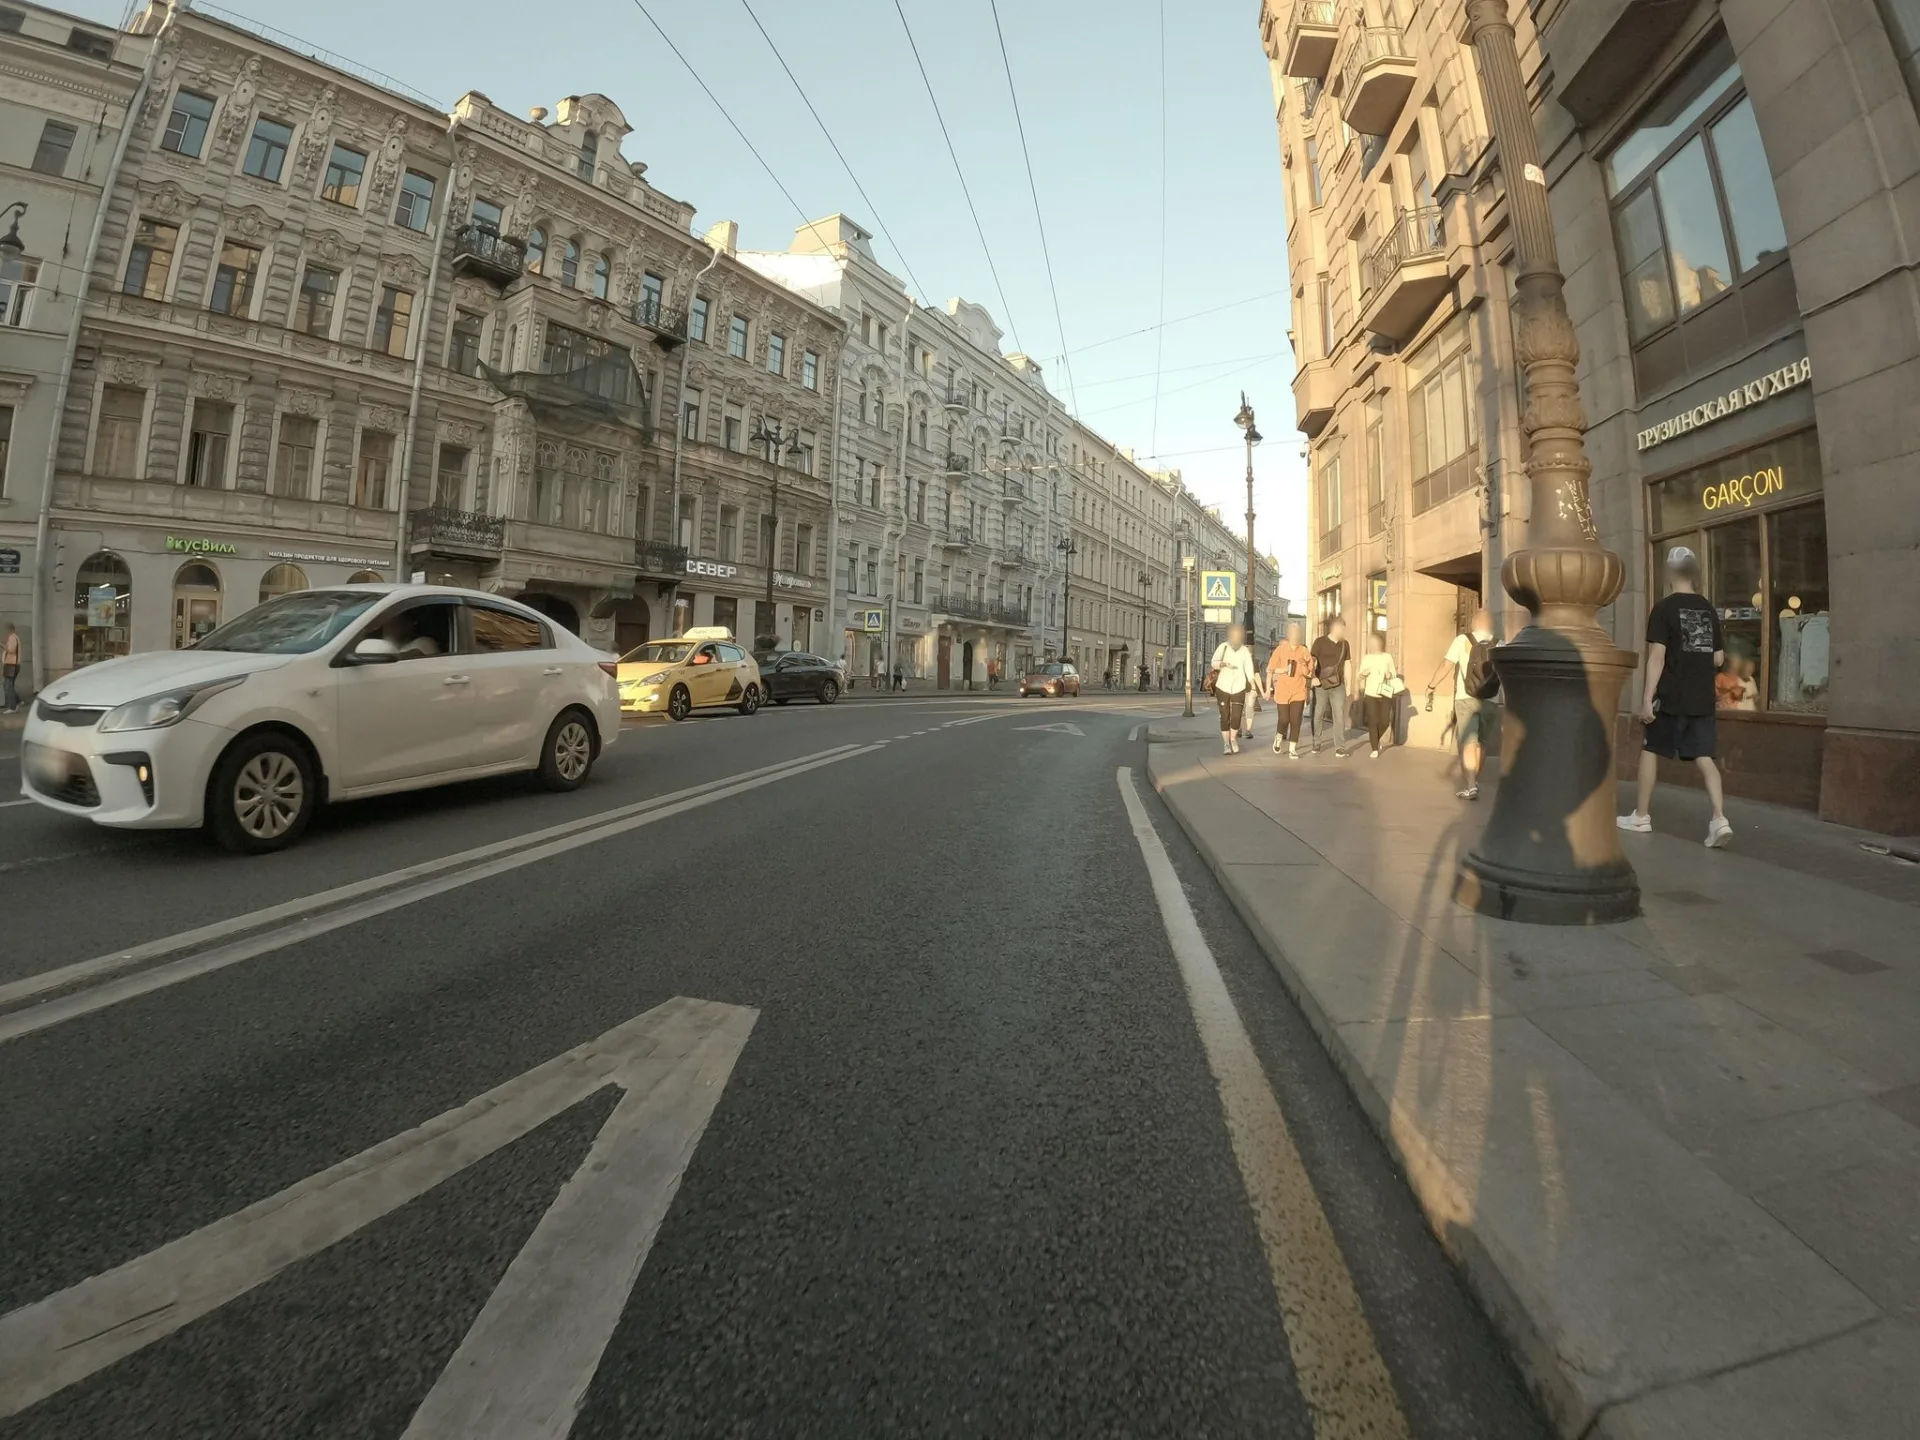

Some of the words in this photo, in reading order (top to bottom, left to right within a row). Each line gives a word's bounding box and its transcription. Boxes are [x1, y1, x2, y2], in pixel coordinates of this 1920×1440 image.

[1637, 389, 1742, 450] ГРУЗИНСКАЯ
[1742, 356, 1812, 405] КУХНЯ
[1703, 466, 1784, 510] GARÇON
[294, 553, 325, 561] ПРОДУКТОВ
[686, 559, 737, 578] СЕВЕР
